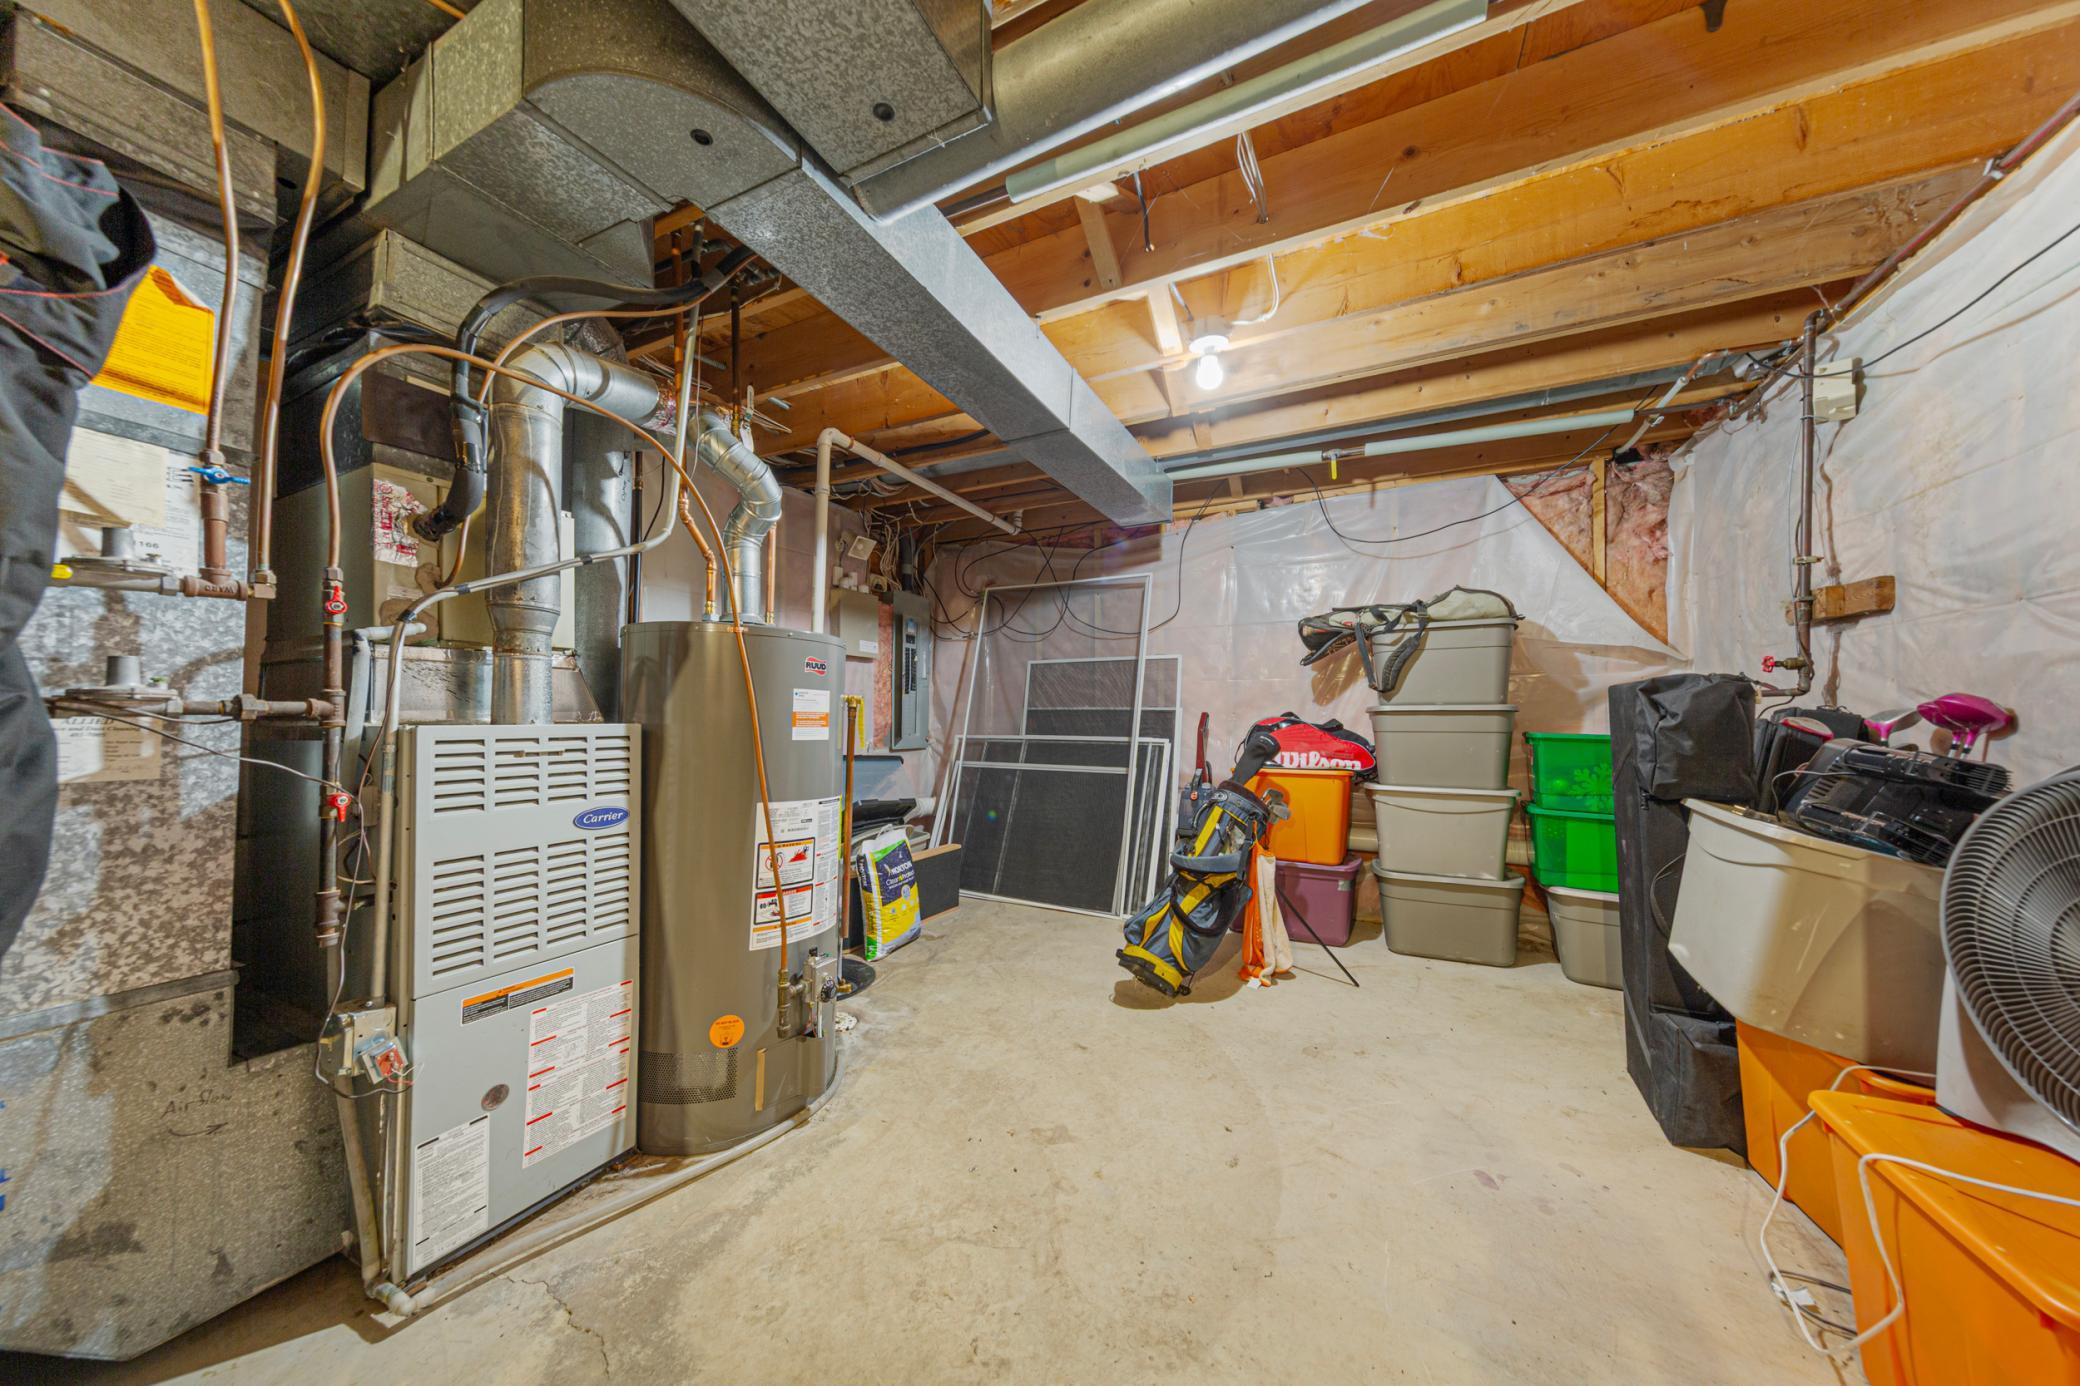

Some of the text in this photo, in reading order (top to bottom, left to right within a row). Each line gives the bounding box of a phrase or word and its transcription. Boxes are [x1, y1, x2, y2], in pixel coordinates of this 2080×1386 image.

[806, 661, 827, 670] RUUD
[1274, 751, 1361, 770] Wilson
[583, 811, 624, 824] Carrier
